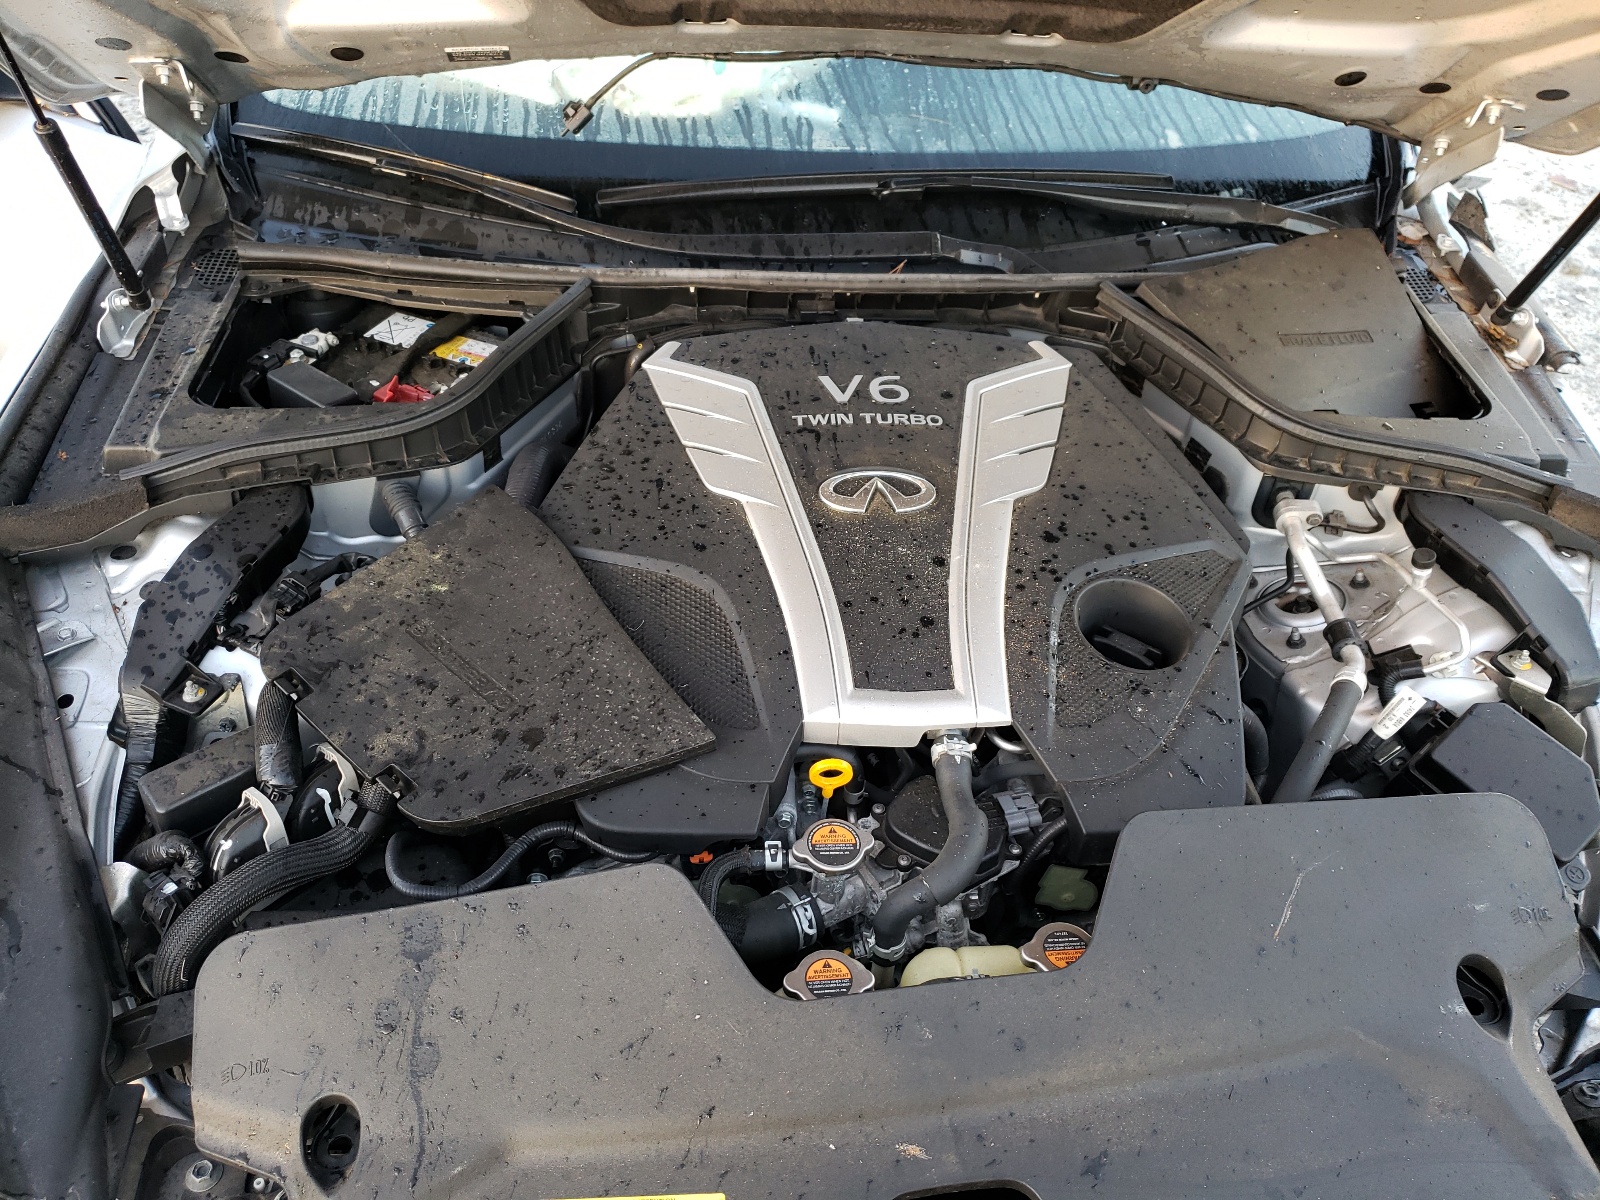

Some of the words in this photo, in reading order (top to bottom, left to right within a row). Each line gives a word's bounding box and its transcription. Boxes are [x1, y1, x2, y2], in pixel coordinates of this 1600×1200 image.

[1280, 335, 1326, 347] BRAKE
[1328, 332, 1370, 344] FLUID
[818, 375, 910, 404] V6
[792, 412, 854, 426] TWIN
[860, 412, 944, 426] TURBO
